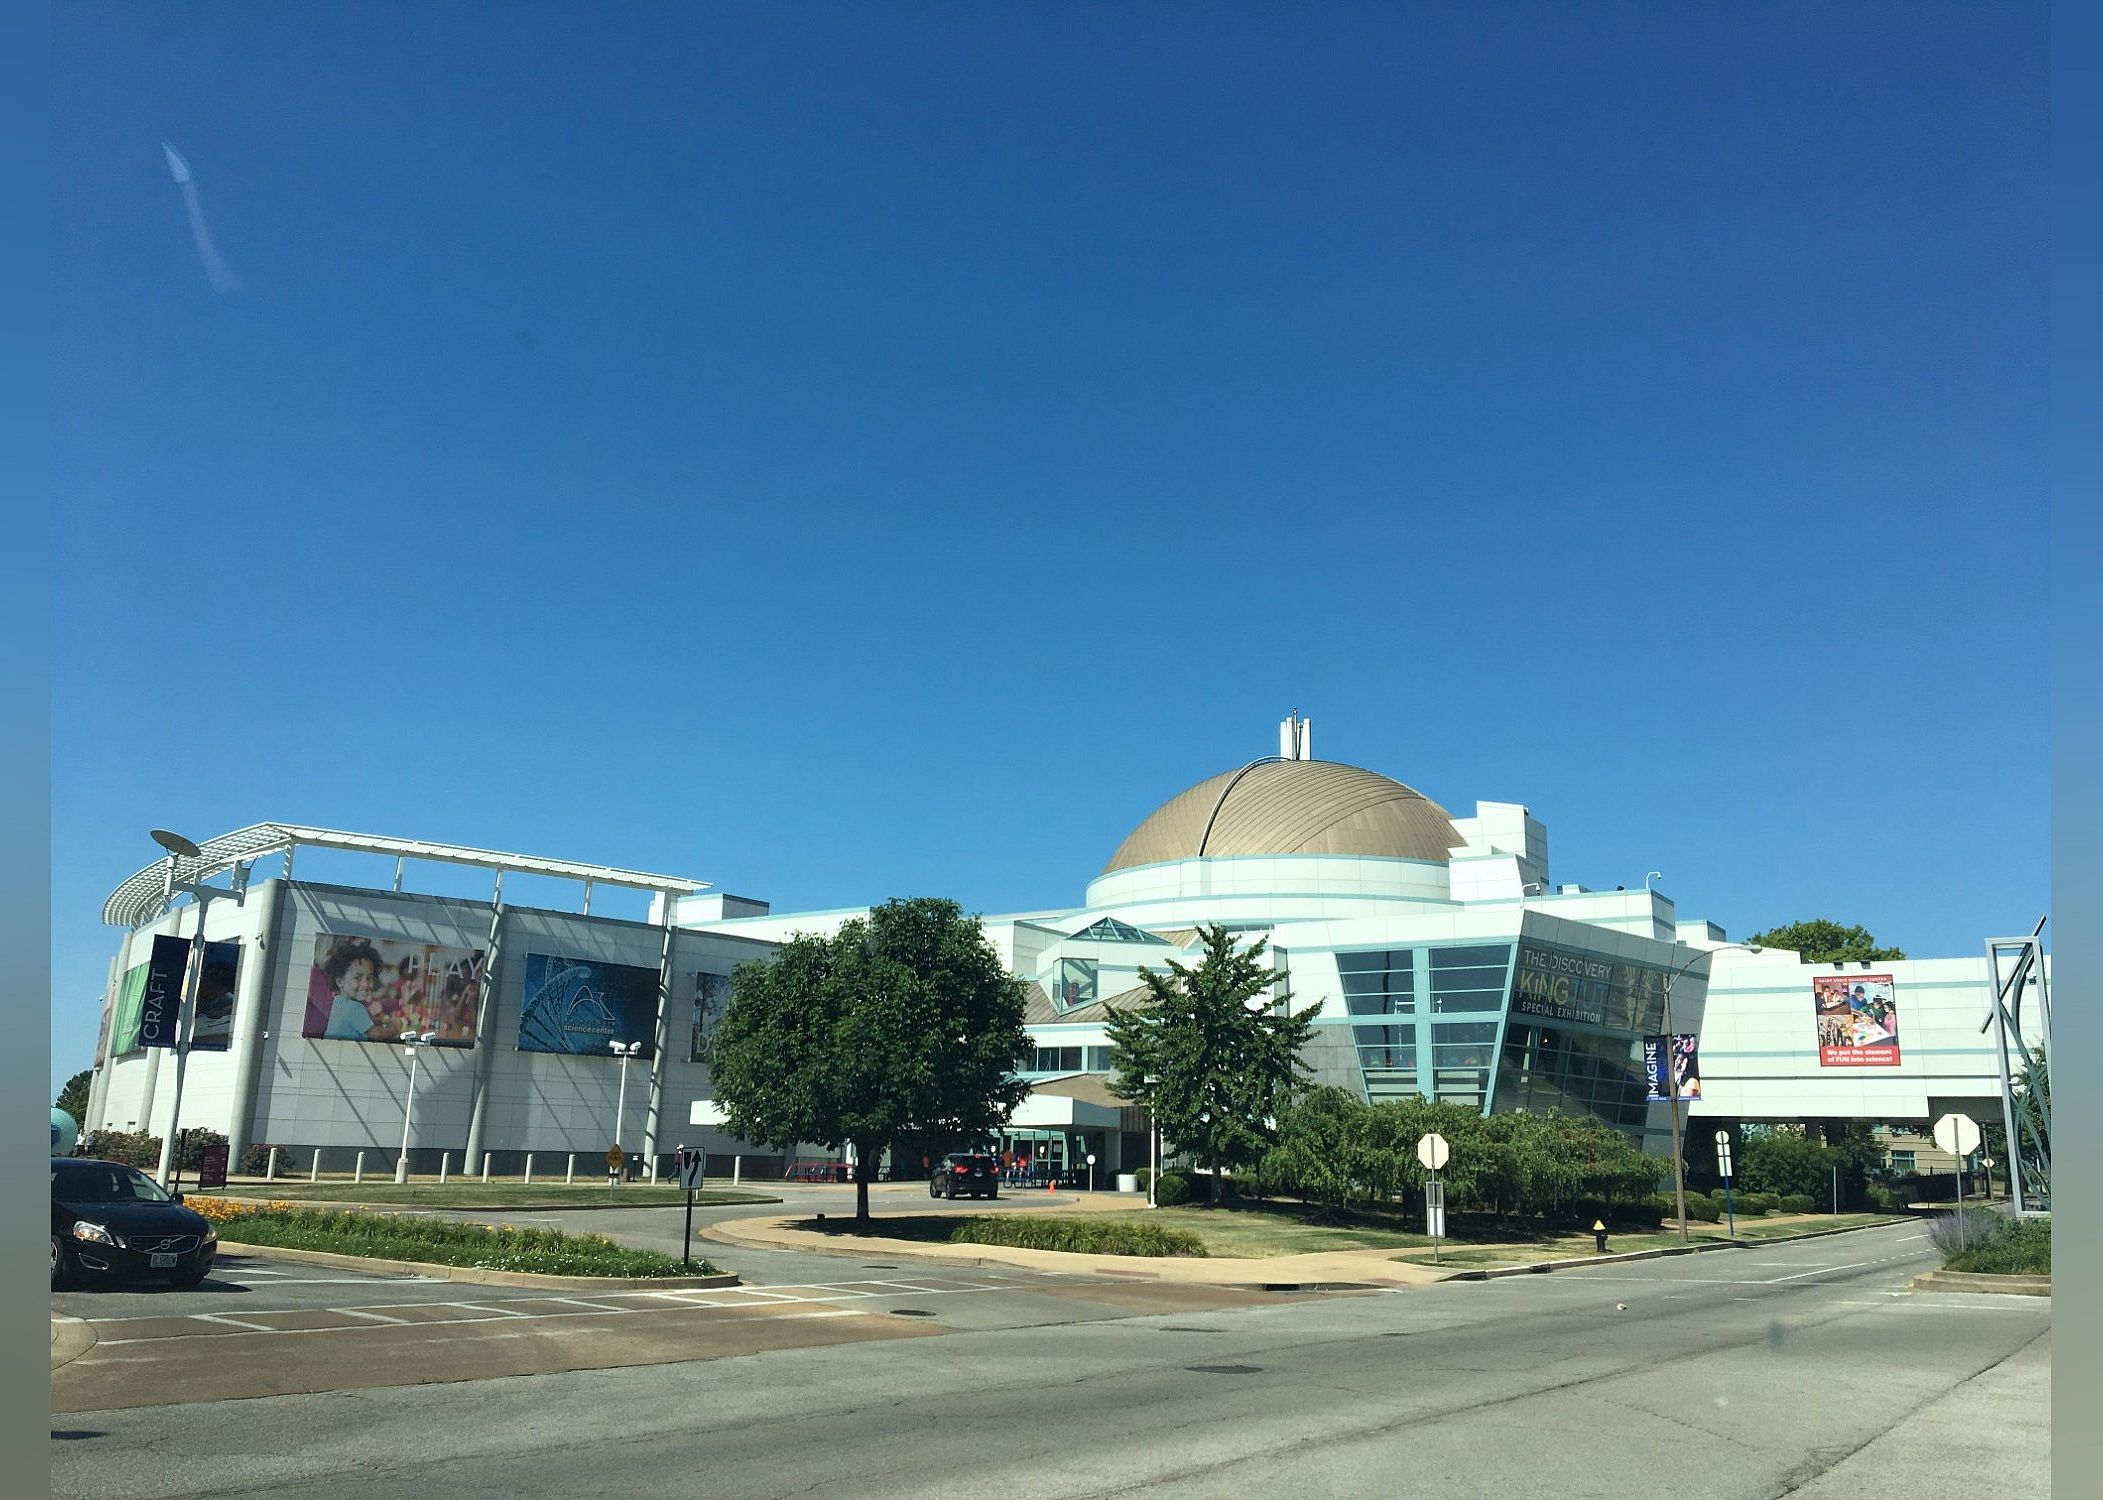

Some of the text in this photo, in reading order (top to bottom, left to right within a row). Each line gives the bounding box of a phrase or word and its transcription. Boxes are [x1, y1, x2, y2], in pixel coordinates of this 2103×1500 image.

[408, 951, 485, 980] PLAY
[1525, 950, 1612, 978] THE DISCOVERY
[143, 967, 168, 1039] CRAFT
[1521, 1001, 1601, 1022] SPECIAL EXHIBITION
[1645, 1042, 1659, 1098] IMAGINE
